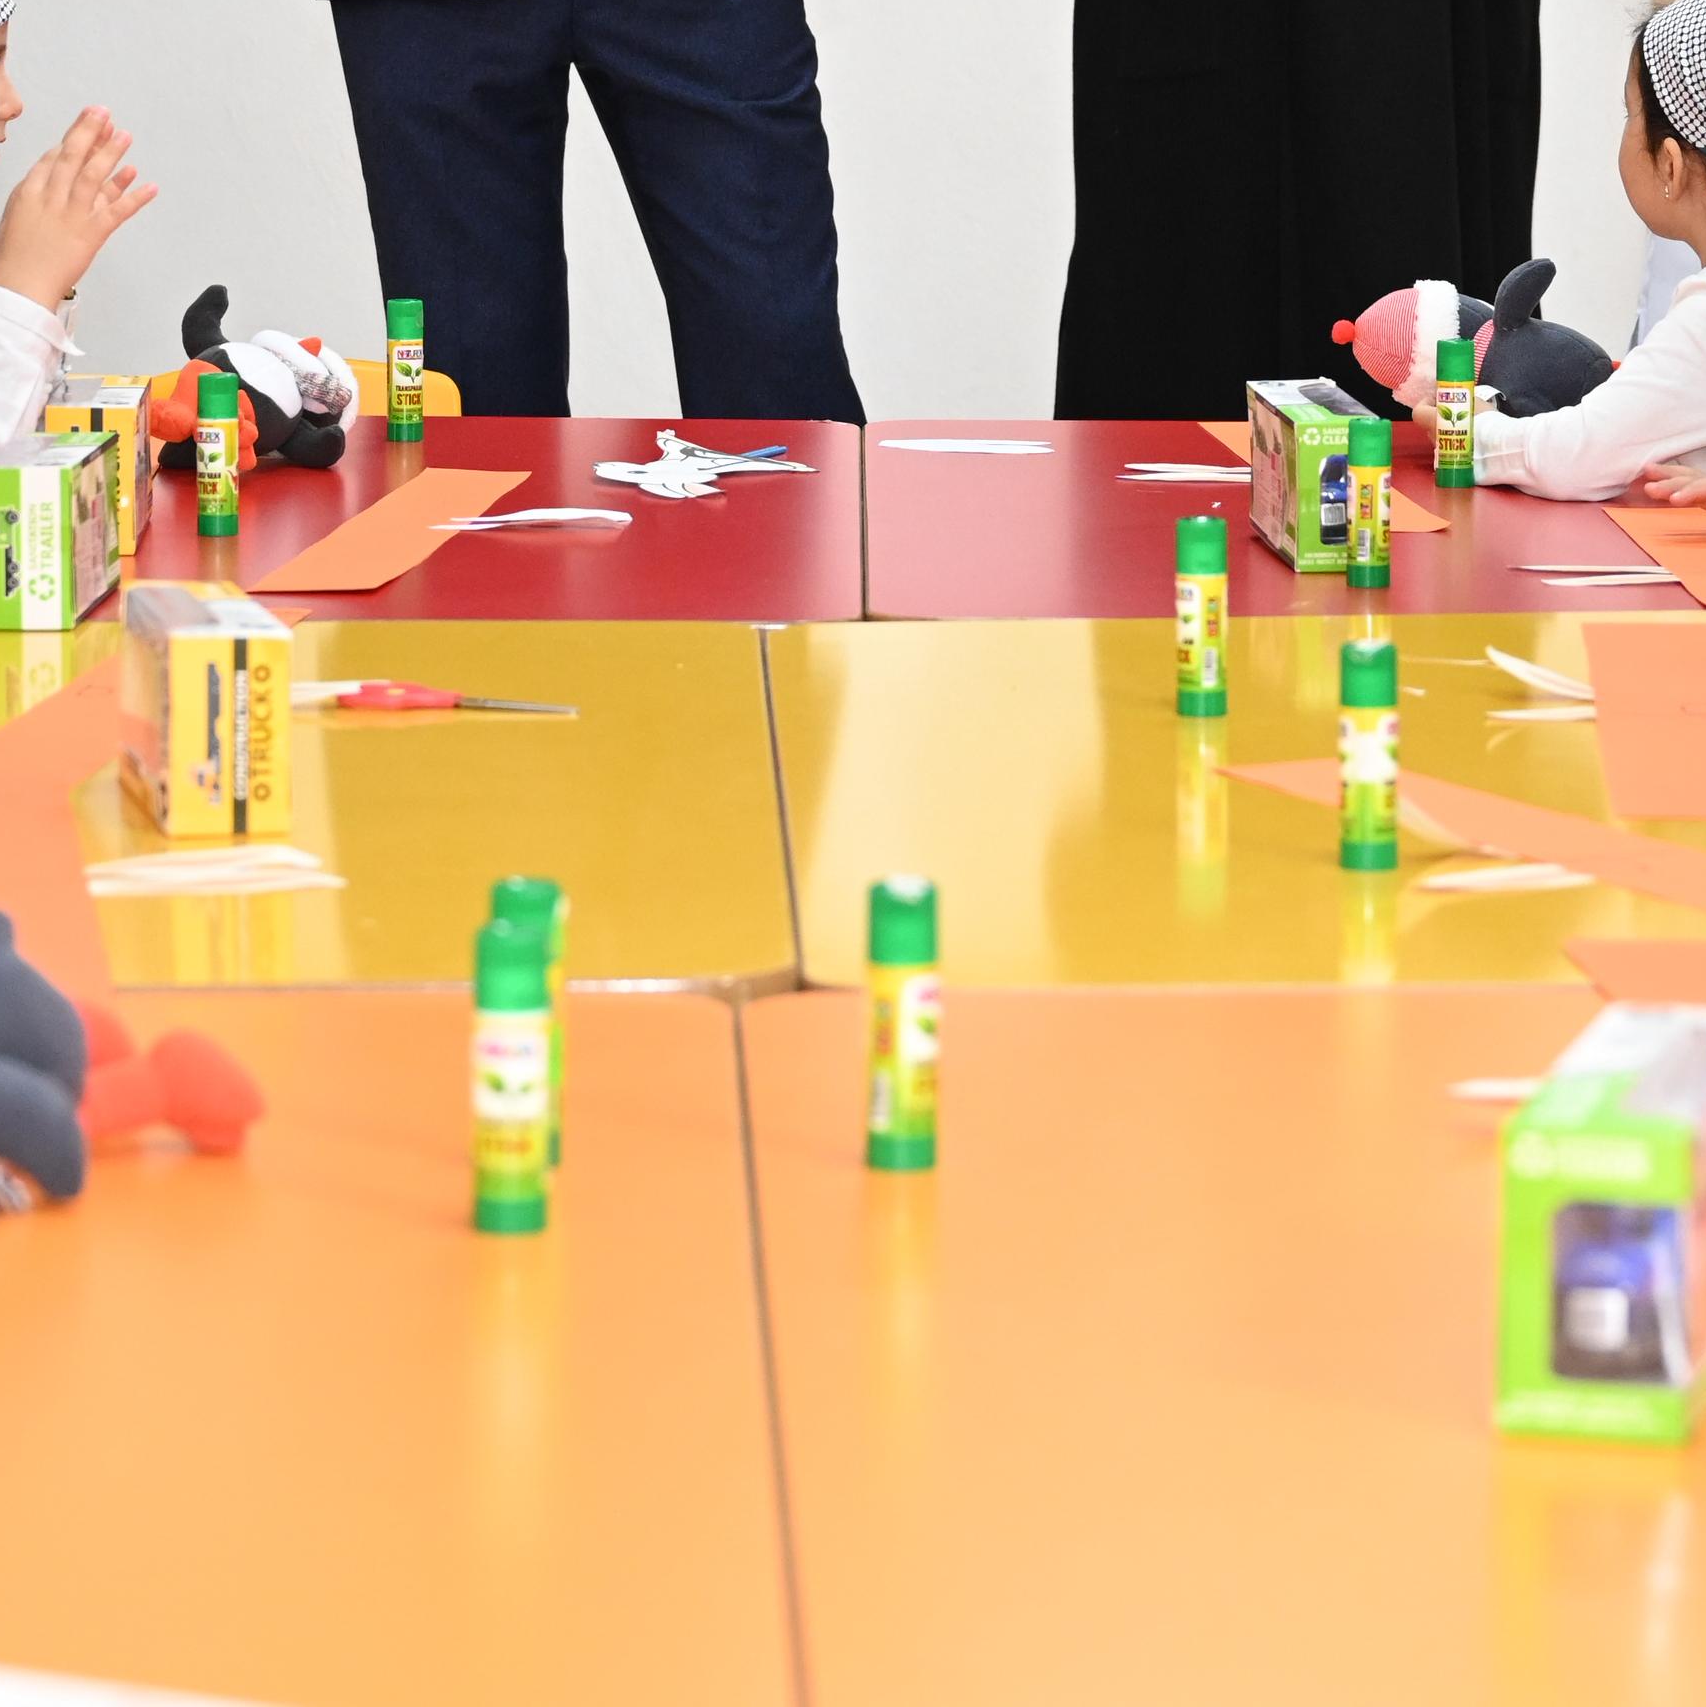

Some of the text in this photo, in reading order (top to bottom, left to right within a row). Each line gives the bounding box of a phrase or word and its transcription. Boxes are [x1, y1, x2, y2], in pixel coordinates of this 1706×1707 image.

[396, 393, 422, 406] STICK
[1322, 435, 1348, 446] CLEA
[1438, 438, 1466, 451] STICK
[198, 481, 219, 495] TICK
[39, 501, 54, 570] TRAILER
[251, 689, 272, 779] TRUCK
